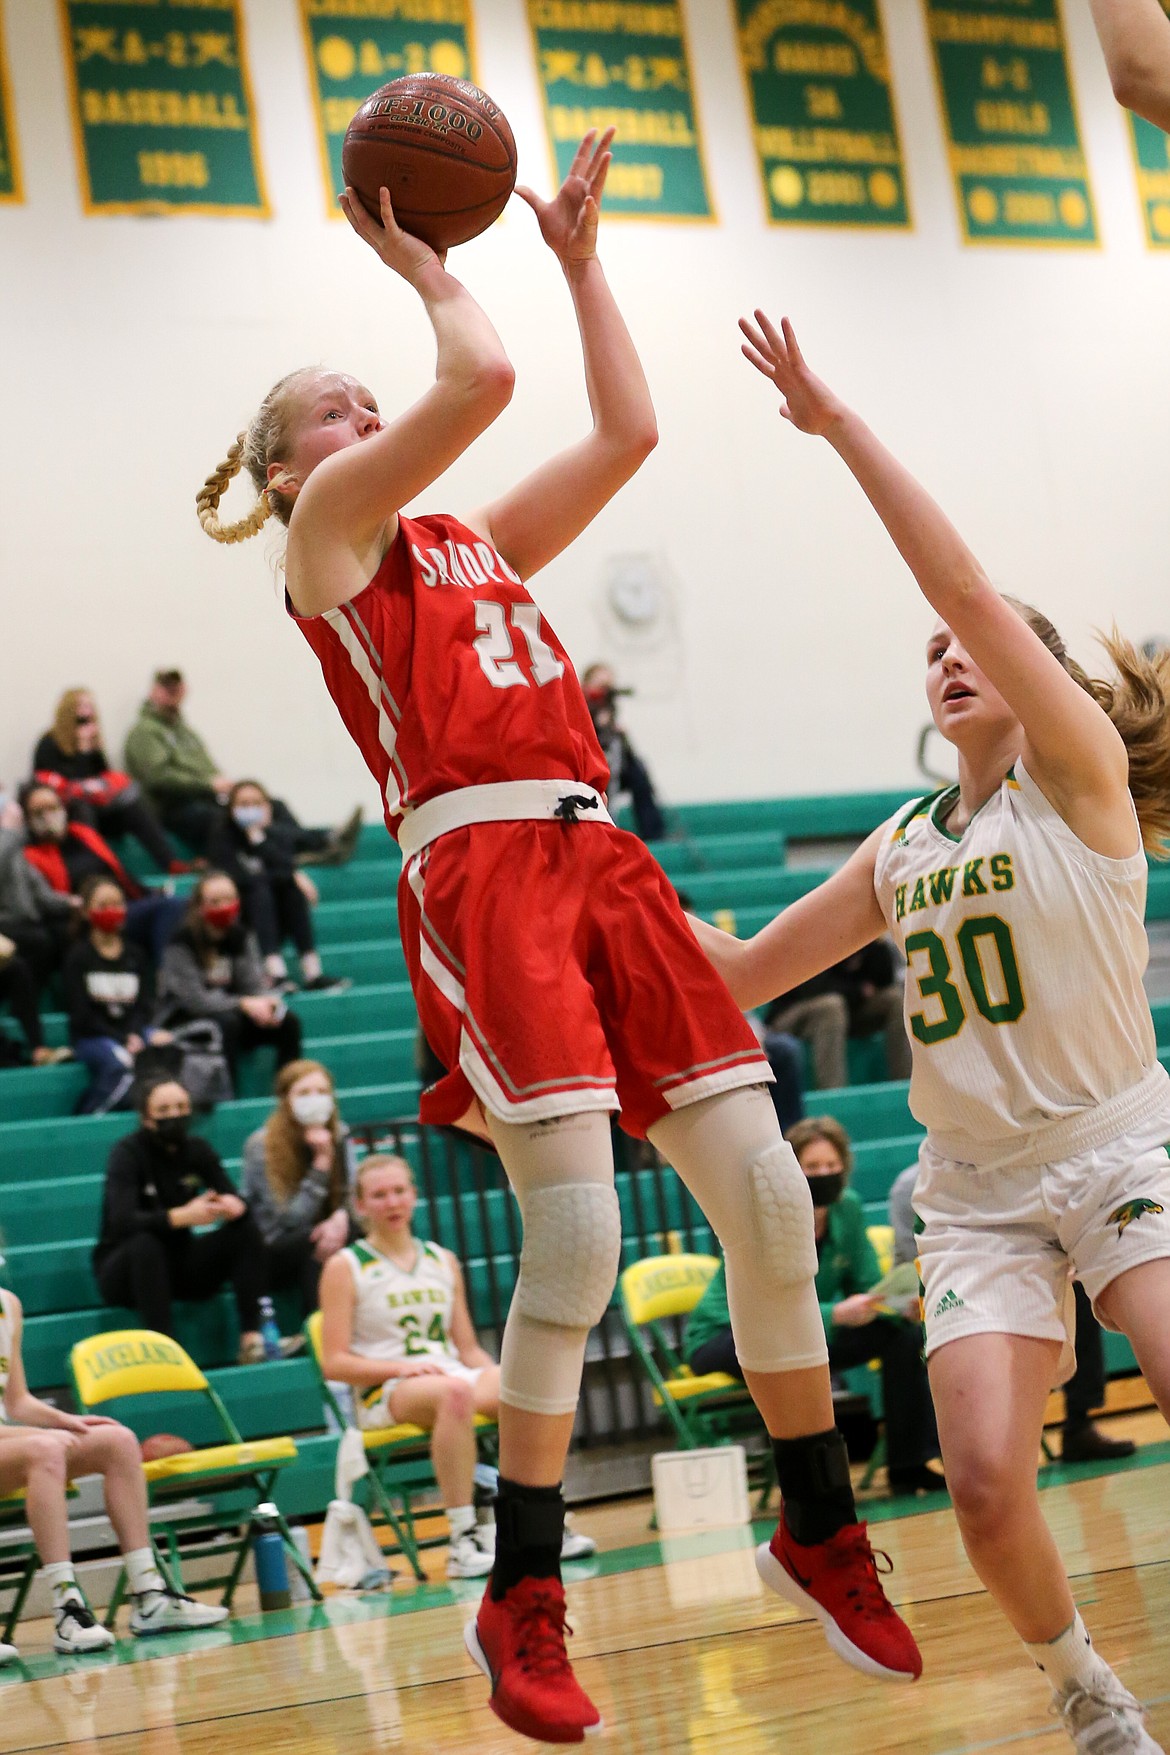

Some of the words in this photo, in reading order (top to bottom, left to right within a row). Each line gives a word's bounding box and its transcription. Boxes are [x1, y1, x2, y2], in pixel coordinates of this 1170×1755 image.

[83, 87, 250, 130] BASEBALL
[370, 96, 484, 141] TF-1000
[472, 599, 566, 689] 21
[894, 852, 1016, 924] HAWKS
[905, 912, 1028, 1048] 30
[396, 1312, 450, 1357] 24
[84, 1341, 183, 1380] LAKELAND
